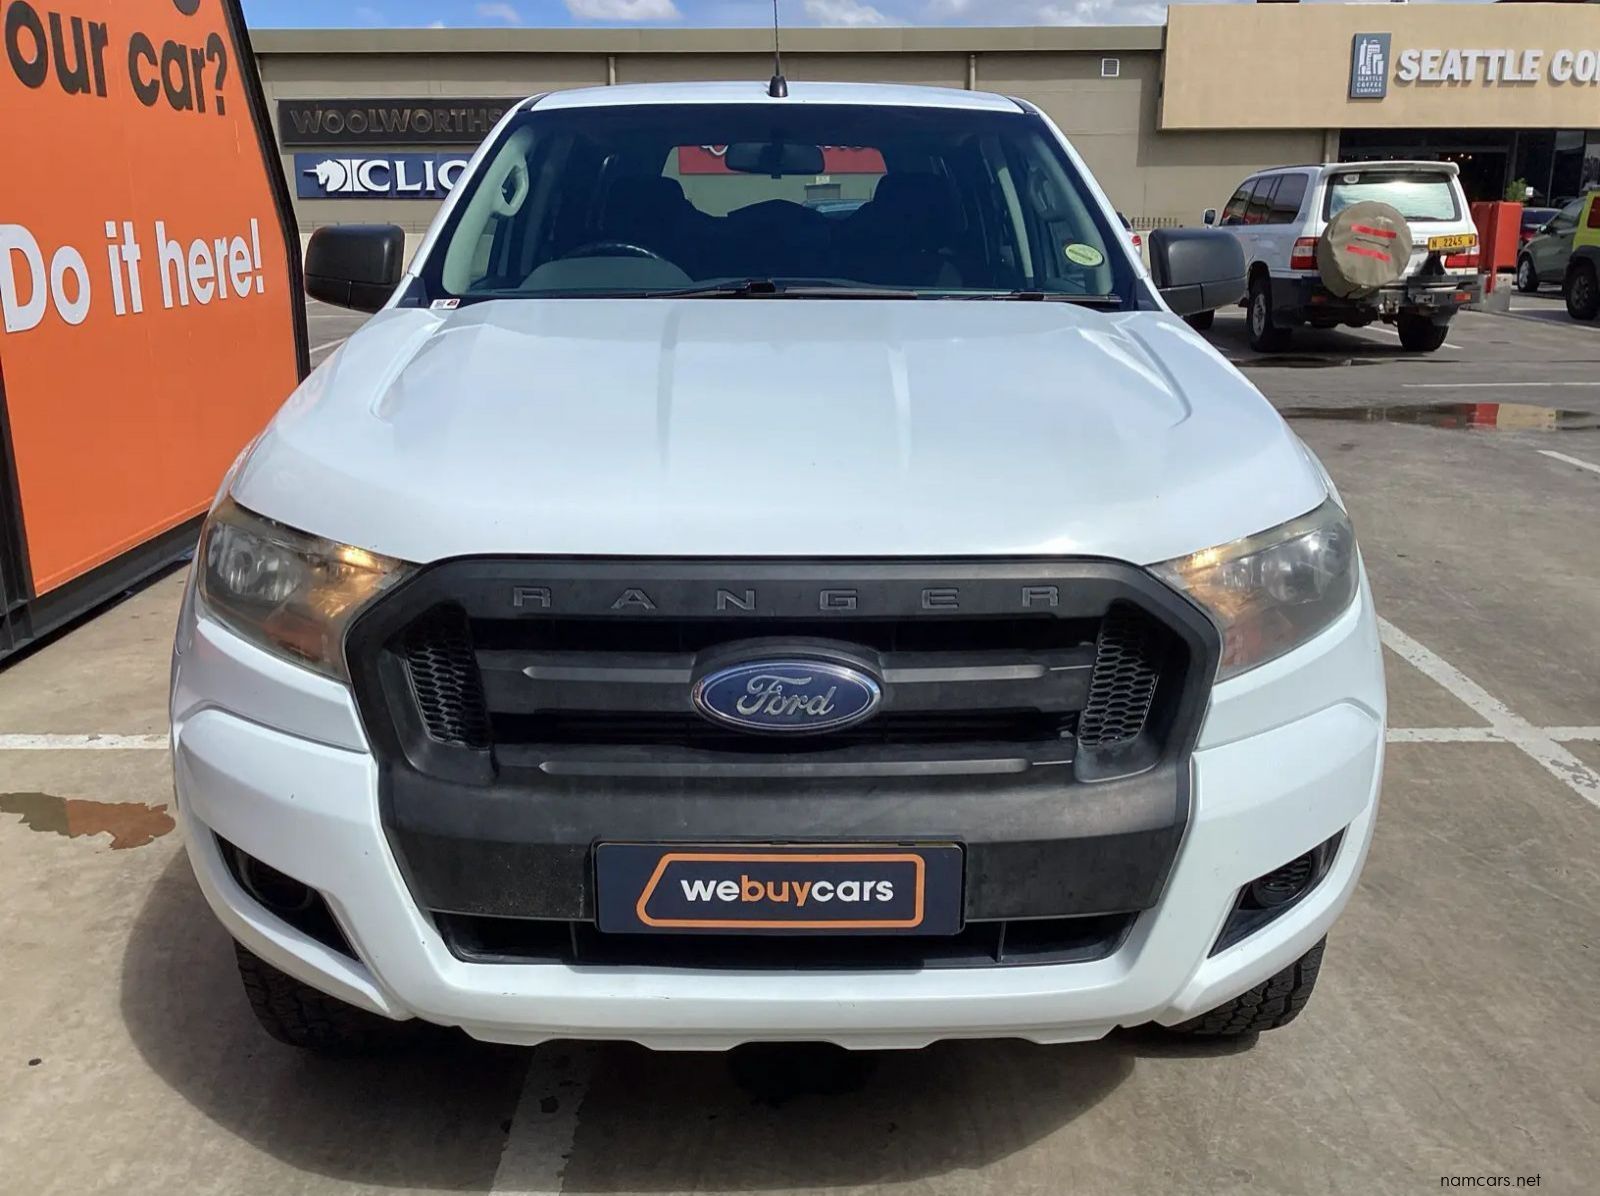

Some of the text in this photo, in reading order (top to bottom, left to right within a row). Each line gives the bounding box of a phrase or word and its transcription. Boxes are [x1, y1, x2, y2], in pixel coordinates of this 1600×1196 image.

[5, 0, 228, 116] our car?
[1398, 49, 1543, 81] SEATTLE
[1431, 239, 1438, 248] N
[1443, 237, 1463, 247] 2245
[0, 218, 265, 333] Do it here!
[512, 585, 1061, 612] RANGER
[736, 673, 836, 717] Ford
[680, 874, 894, 907] webuycars
